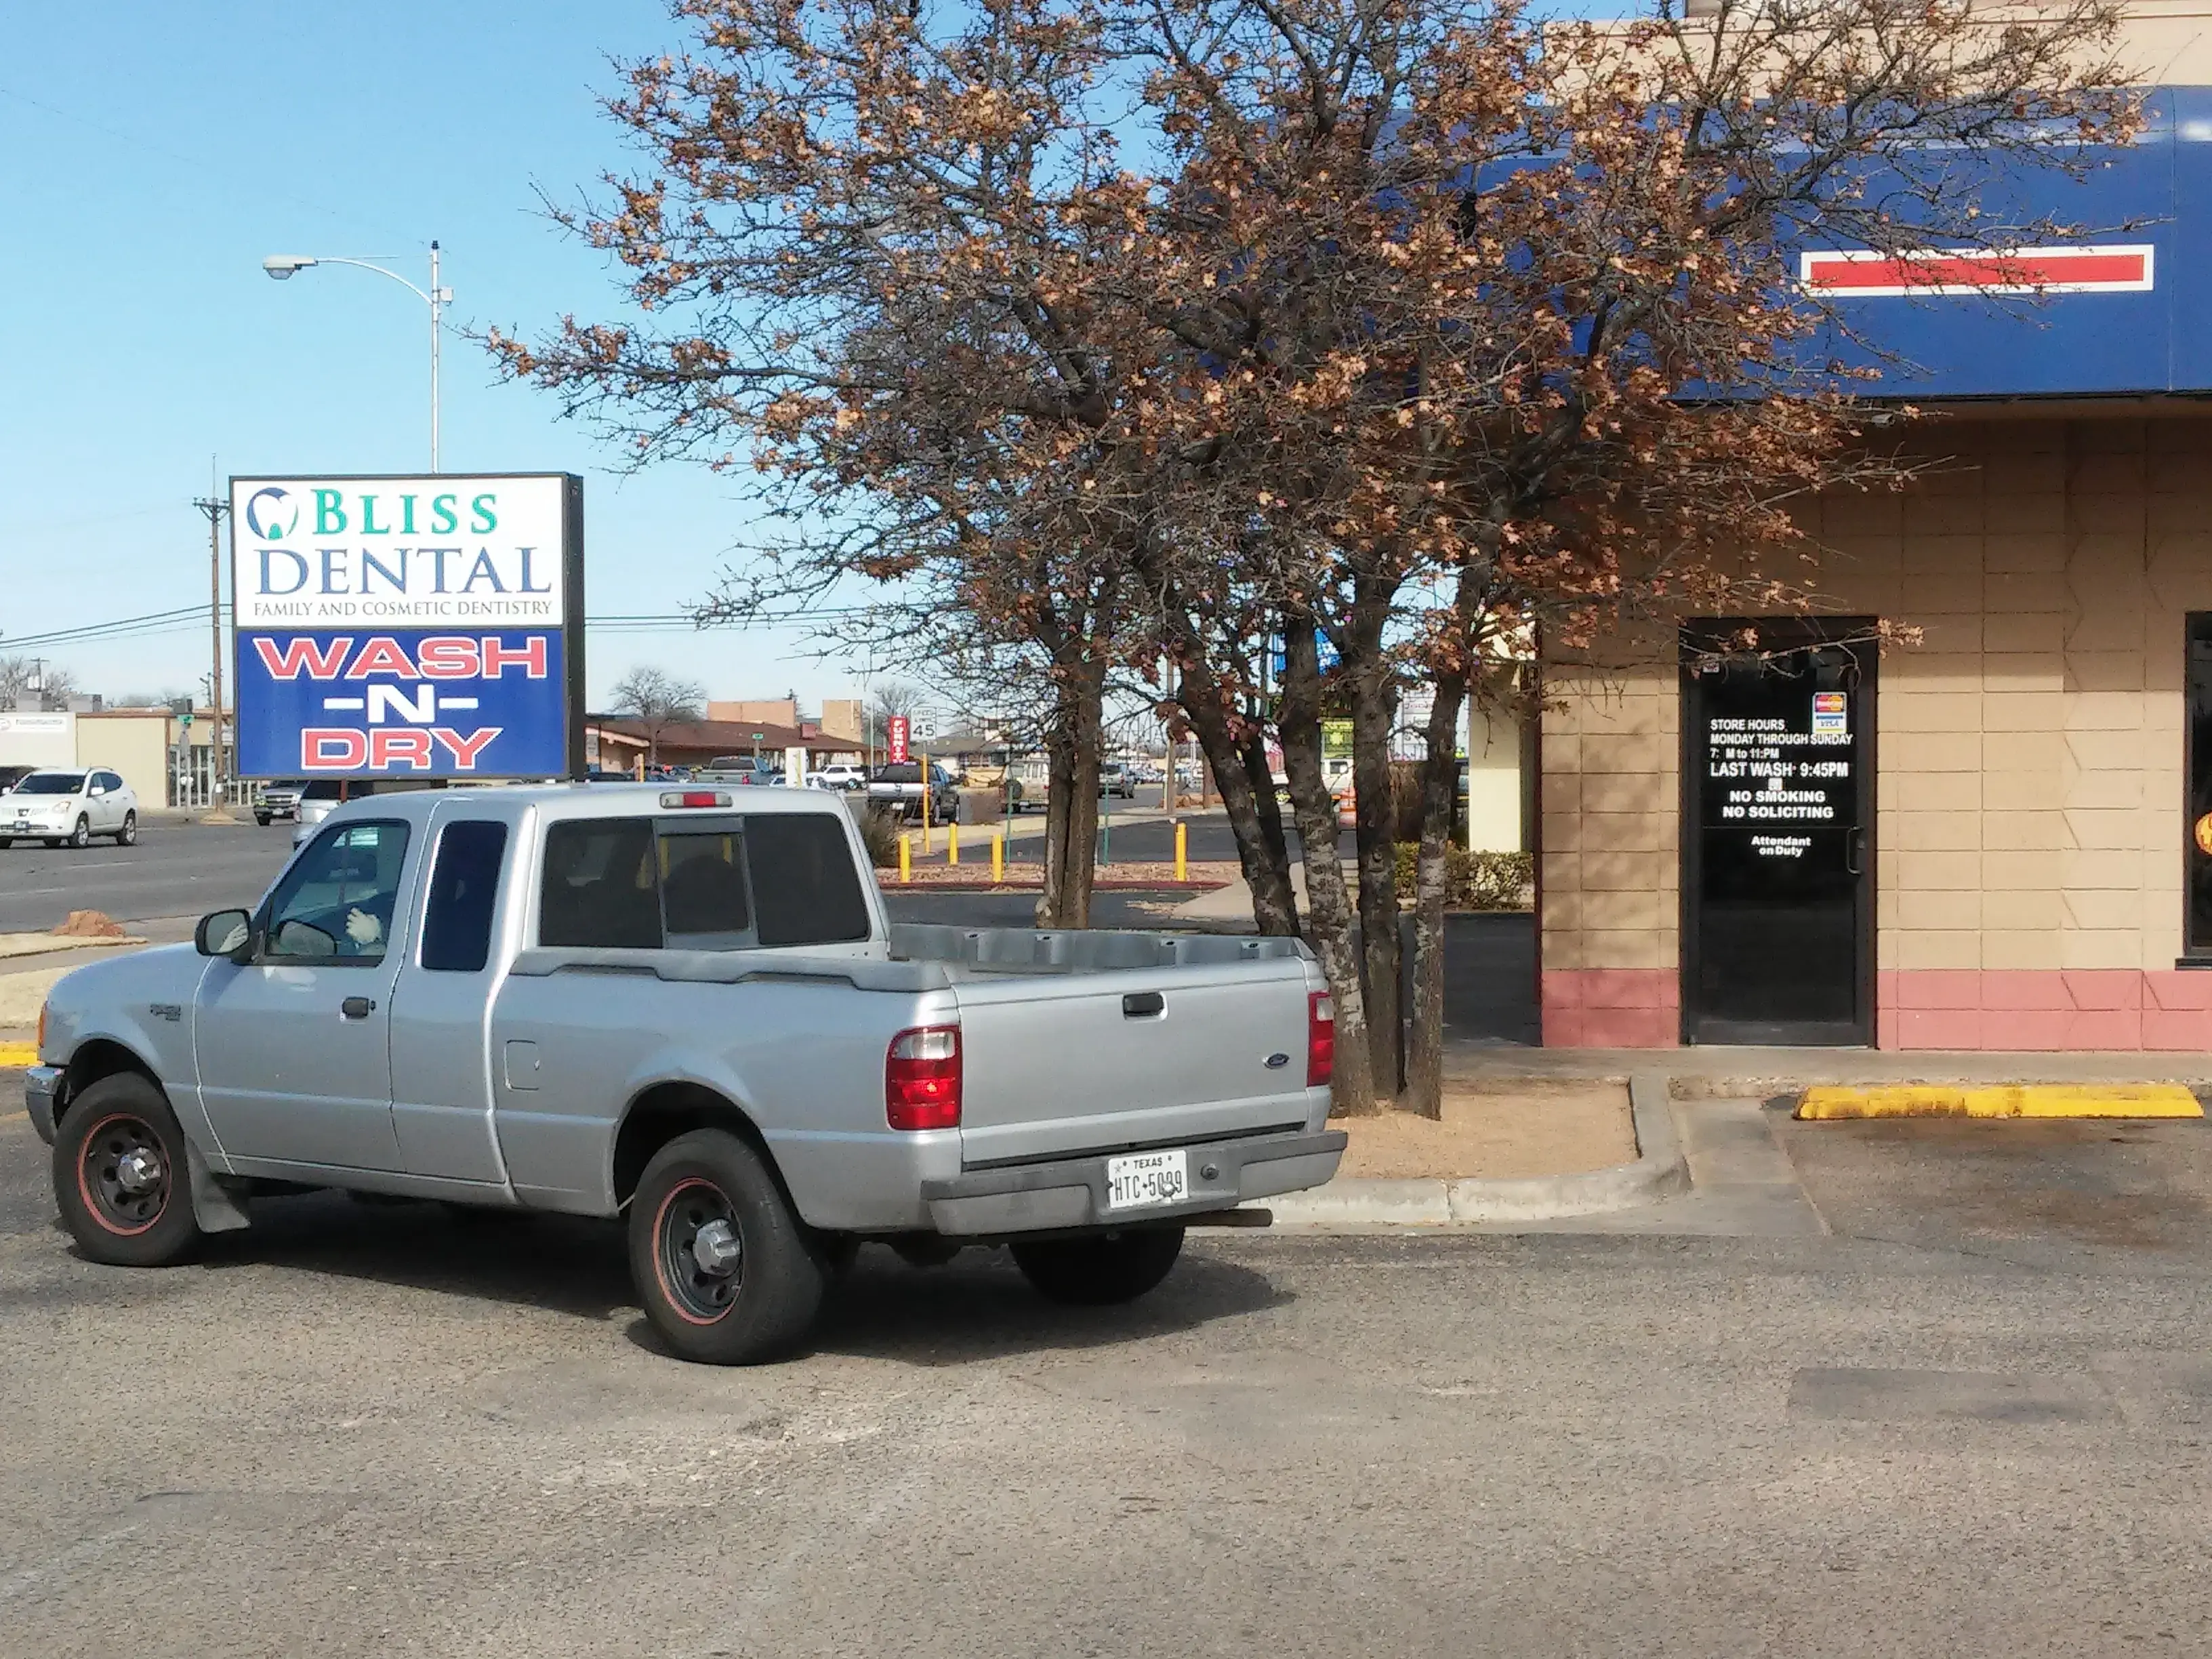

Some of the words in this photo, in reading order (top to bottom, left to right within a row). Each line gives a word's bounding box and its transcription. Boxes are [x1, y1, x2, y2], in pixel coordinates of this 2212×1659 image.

[310, 488, 498, 535] BLISS
[253, 547, 552, 594] DENTAL
[254, 602, 312, 617] FAMILY
[319, 602, 356, 616] AND
[362, 602, 451, 616] COSMETIC
[458, 601, 552, 615] DENTISTRY
[253, 637, 547, 680] WASH
[323, 684, 478, 723] -N-
[913, 724, 935, 737] 45
[1711, 719, 1745, 731] STORE
[1711, 734, 1755, 745] MONDAY
[1757, 734, 1808, 745] THROUGH
[1810, 734, 1853, 745] SUNDAY
[301, 729, 504, 770] DRY
[1737, 748, 1747, 758] to
[1711, 762, 1747, 777] LAST
[1800, 762, 1849, 777] 9:45PM
[1729, 791, 1752, 802] NO
[1756, 791, 1826, 802] SMOKING
[1723, 806, 1745, 818] NO
[1748, 806, 1834, 818] SOLICITING
[1751, 836, 1811, 846] Attendant
[1759, 847, 1774, 855] on
[1776, 846, 1803, 857] Duty
[1134, 1157, 1163, 1169] TEXAS
